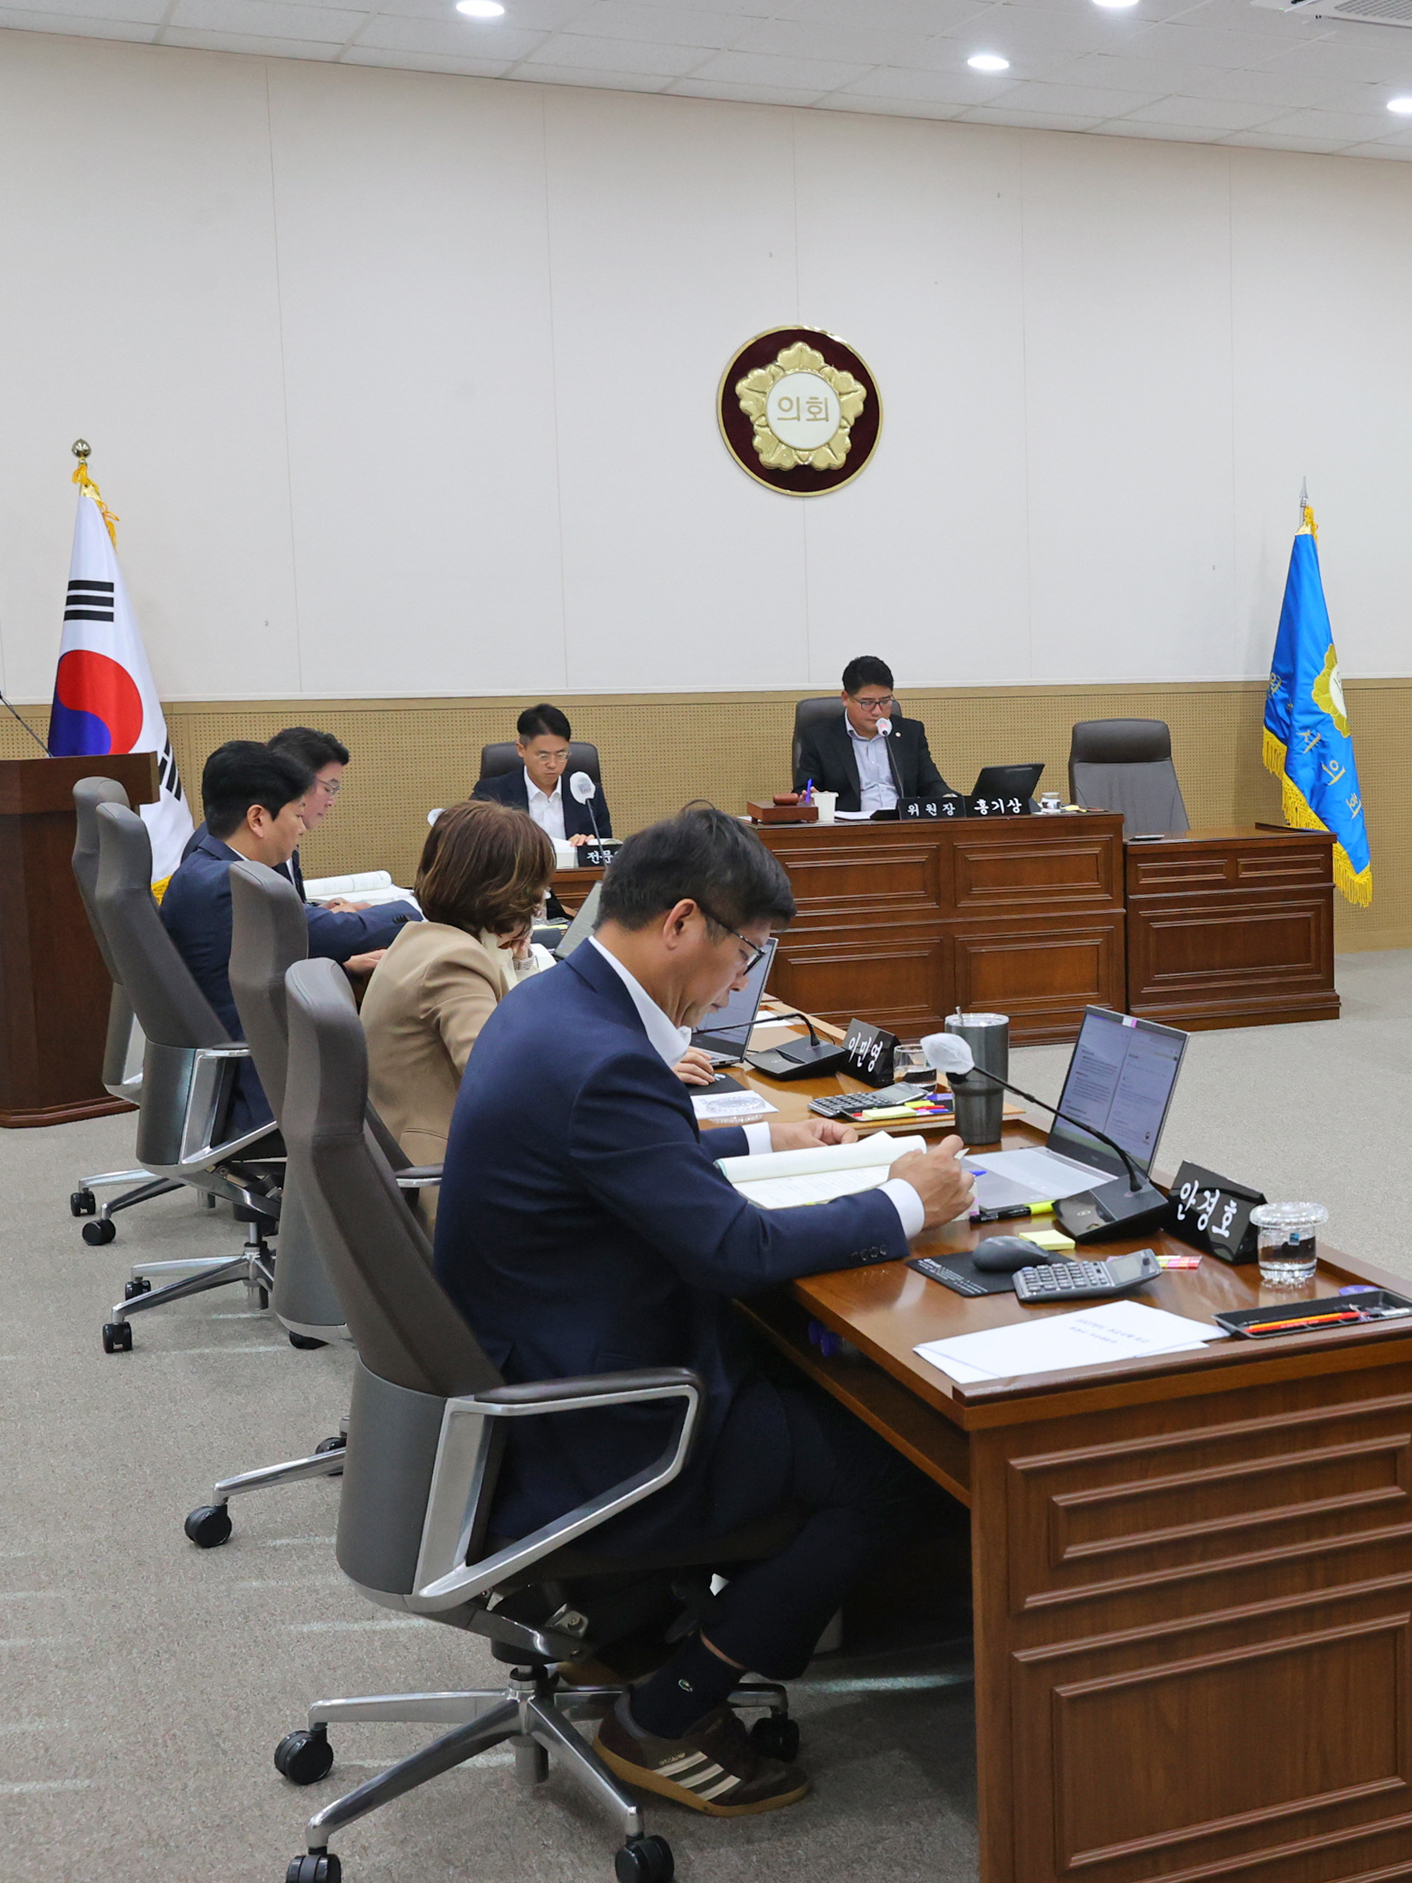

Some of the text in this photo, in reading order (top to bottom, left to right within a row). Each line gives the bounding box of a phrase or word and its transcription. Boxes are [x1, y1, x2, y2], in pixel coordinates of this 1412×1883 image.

[777, 396, 829, 422] 의회
[907, 802, 956, 817] 위원장
[973, 798, 1023, 816] 홍기상
[586, 849, 619, 864] 전문
[848, 1031, 884, 1073] 이민영
[1176, 1179, 1238, 1239] 안경호
